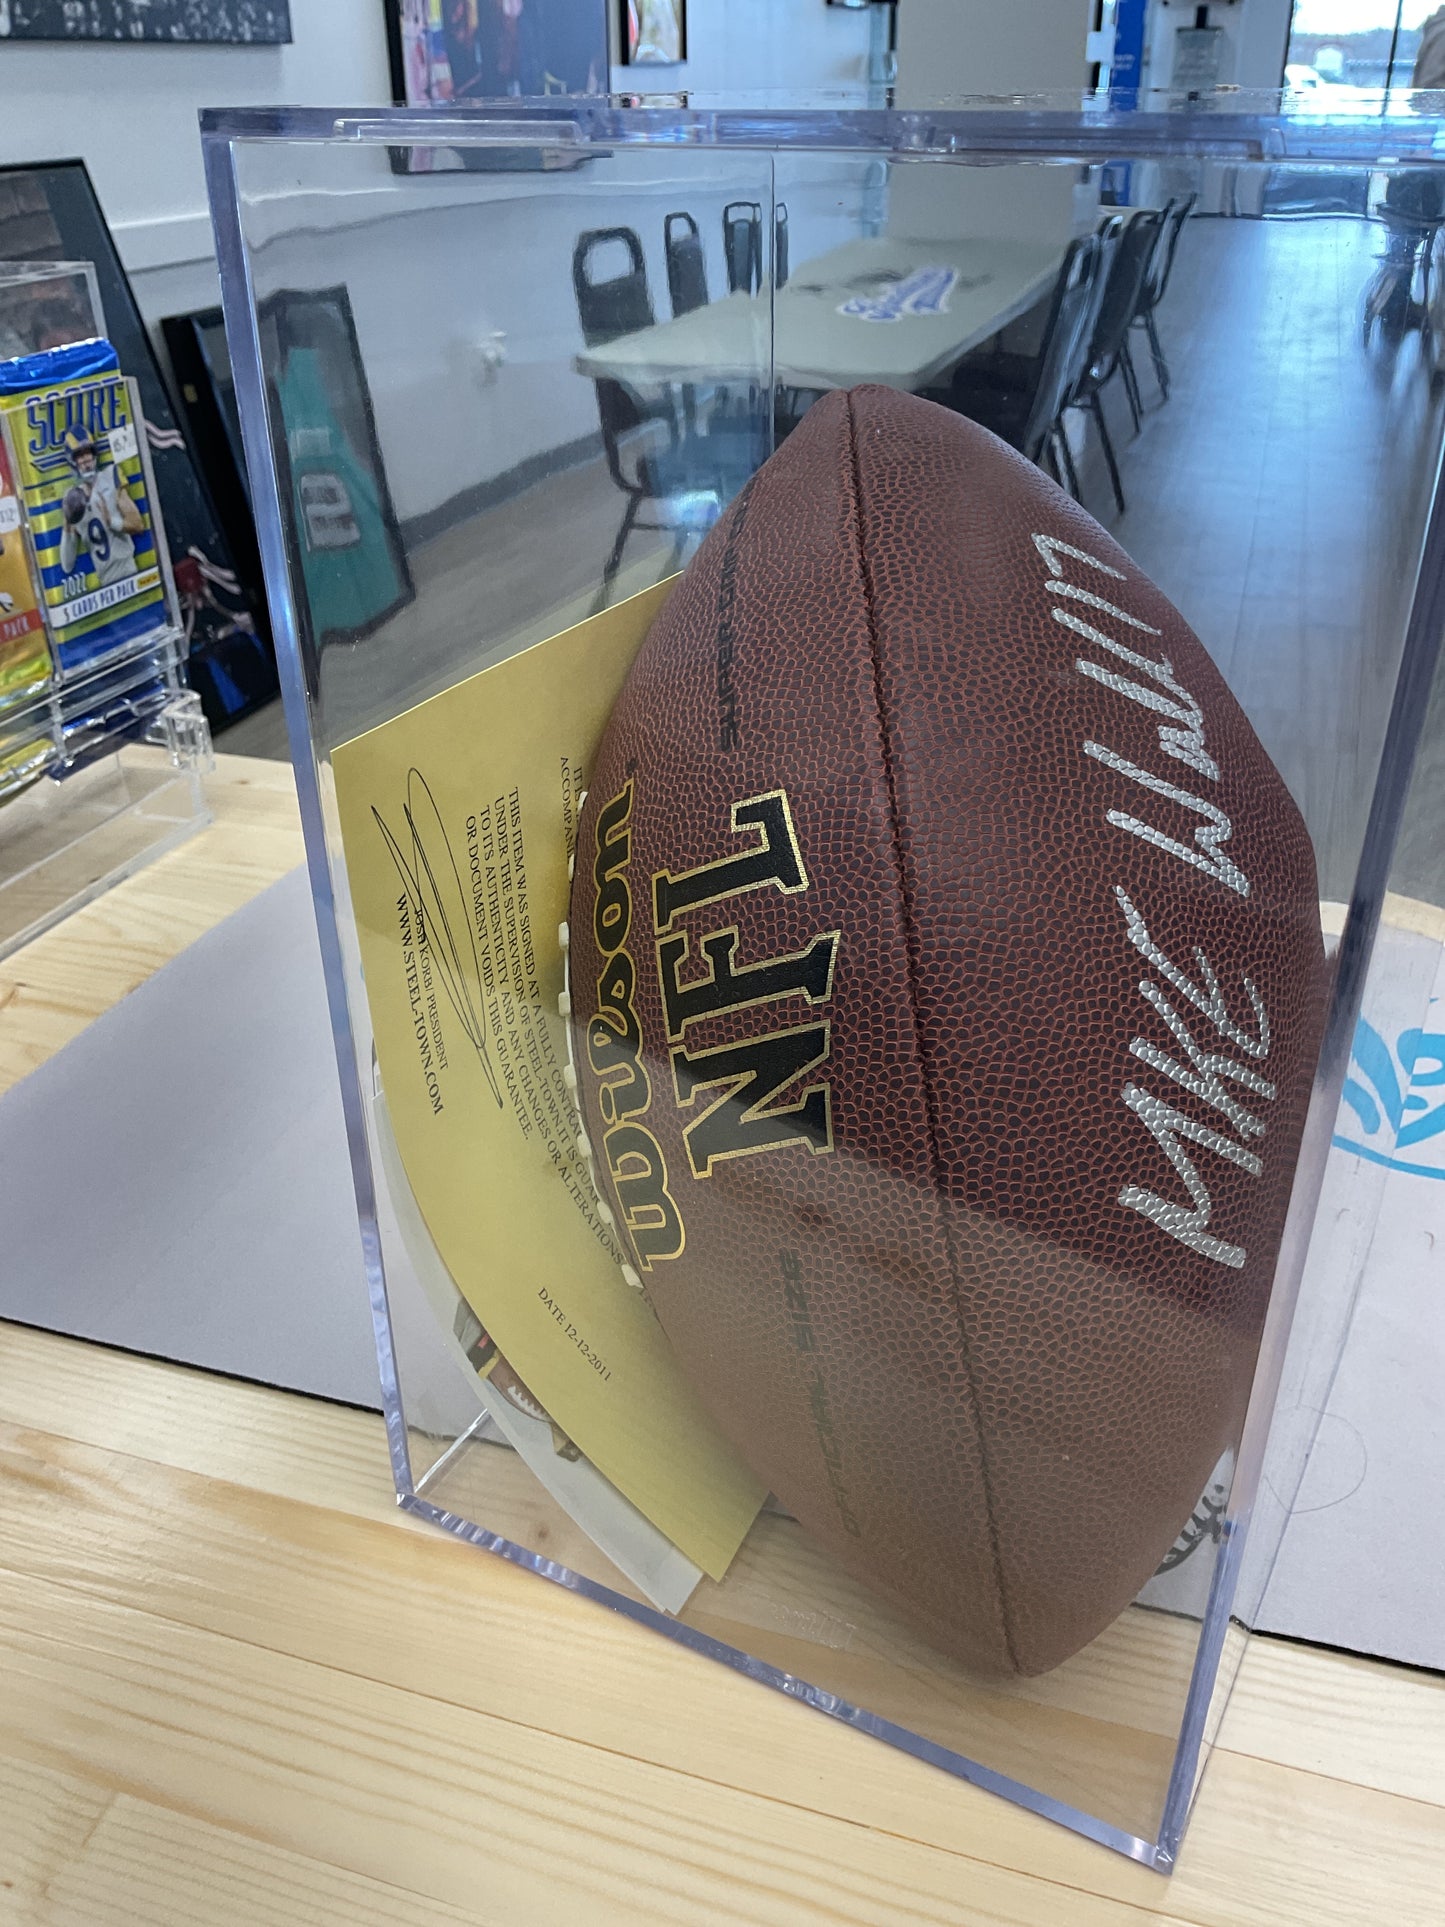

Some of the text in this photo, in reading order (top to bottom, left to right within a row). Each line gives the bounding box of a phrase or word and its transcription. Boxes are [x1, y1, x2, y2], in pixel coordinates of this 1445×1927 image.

[25, 376, 126, 456] SCORE
[88, 517, 110, 562] 9
[61, 572, 87, 599] 2022
[72, 598, 99, 619] CARDS
[99, 586, 115, 607] PER
[116, 579, 136, 600] PACK
[717, 620, 738, 752] SUPER
[573, 766, 583, 781] IT
[494, 796, 509, 860] UNDER
[508, 786, 521, 828] THIS
[512, 828, 525, 875] ITEM
[501, 859, 513, 896] THE
[516, 873, 529, 914] WAS
[503, 896, 526, 1004] SUPERVISION
[520, 914, 536, 976] SIGNED
[396, 891, 444, 1115] WWW.STEEL-TOWN.COM
[465, 815, 534, 1141] OR DOCUMENT VOIDS THIS GUARANTEE.
[528, 980, 541, 999] AT
[651, 788, 842, 1181] NFL
[426, 992, 449, 1071] PRESIDENT
[480, 804, 625, 1266] TO ITS AUTHENTICITY AND ANY CHANGES OR ALTERATIONS
[519, 1005, 531, 1026] OF
[533, 1004, 542, 1017] A
[586, 778, 687, 1273] Wilson
[536, 1016, 557, 1067] FULLY
[566, 1145, 578, 1162] IS
[538, 1287, 612, 1381] DATE 12-12-2011
